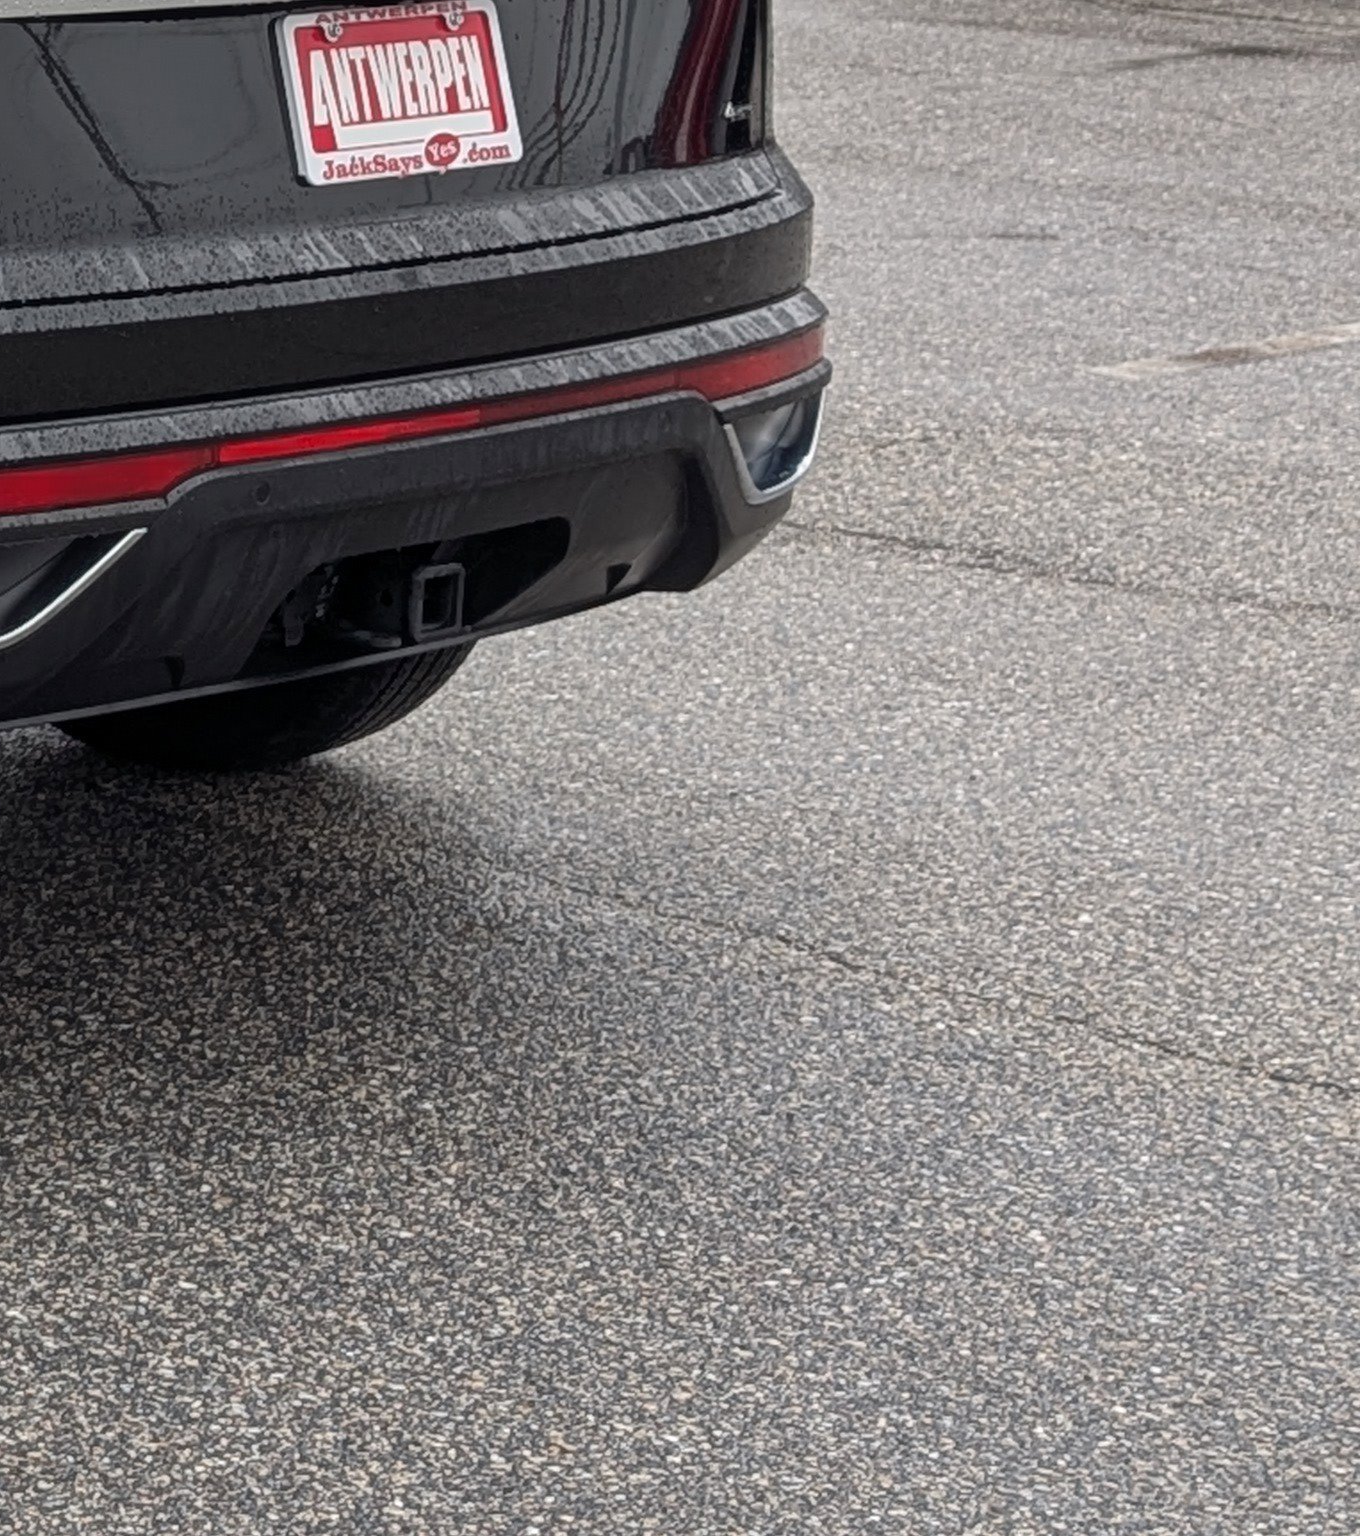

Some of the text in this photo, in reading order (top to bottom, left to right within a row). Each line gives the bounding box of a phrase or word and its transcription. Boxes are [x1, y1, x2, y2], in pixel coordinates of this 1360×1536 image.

[315, 0, 468, 24] ANTWERPEN
[308, 33, 491, 127] ANTWERPEN
[322, 152, 424, 181] JackSays
[427, 139, 458, 162] Yes
